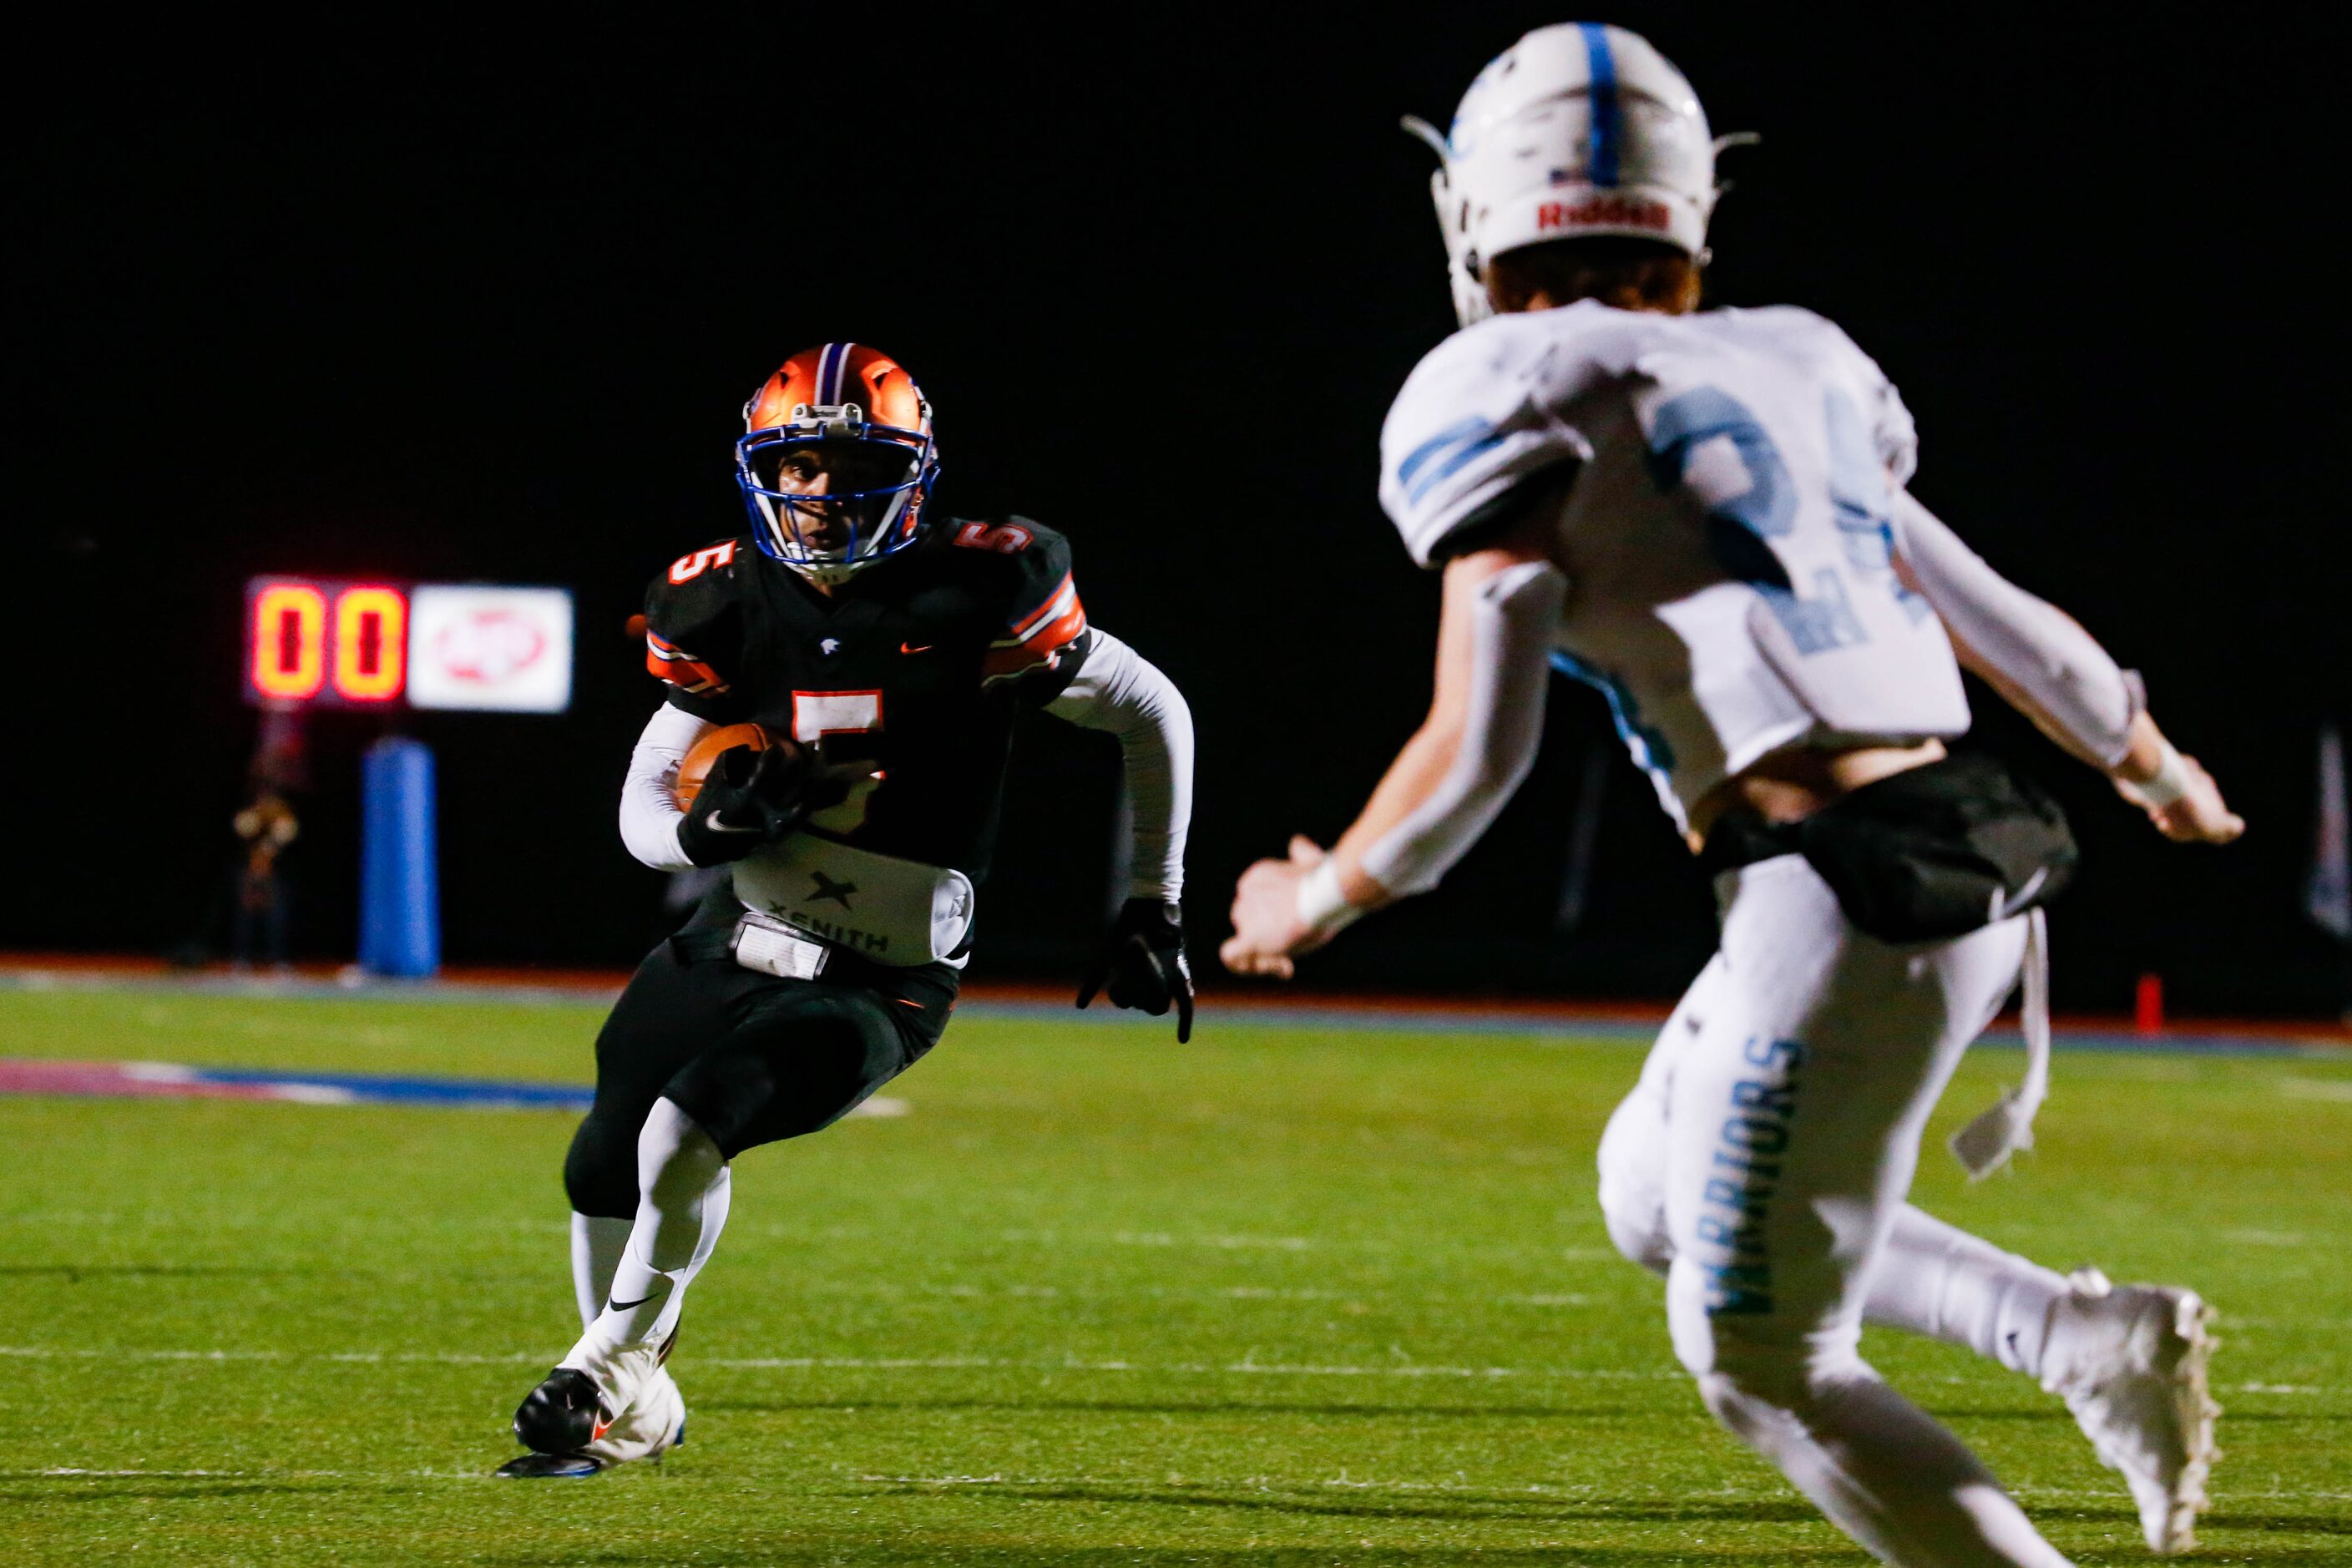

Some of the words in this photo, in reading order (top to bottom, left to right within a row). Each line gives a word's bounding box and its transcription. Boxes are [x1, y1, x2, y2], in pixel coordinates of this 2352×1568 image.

[669, 539, 737, 585] 5
[953, 523, 1034, 554] 5
[252, 583, 410, 701] 00
[792, 690, 885, 833] 5
[768, 899, 888, 952] XENITH
